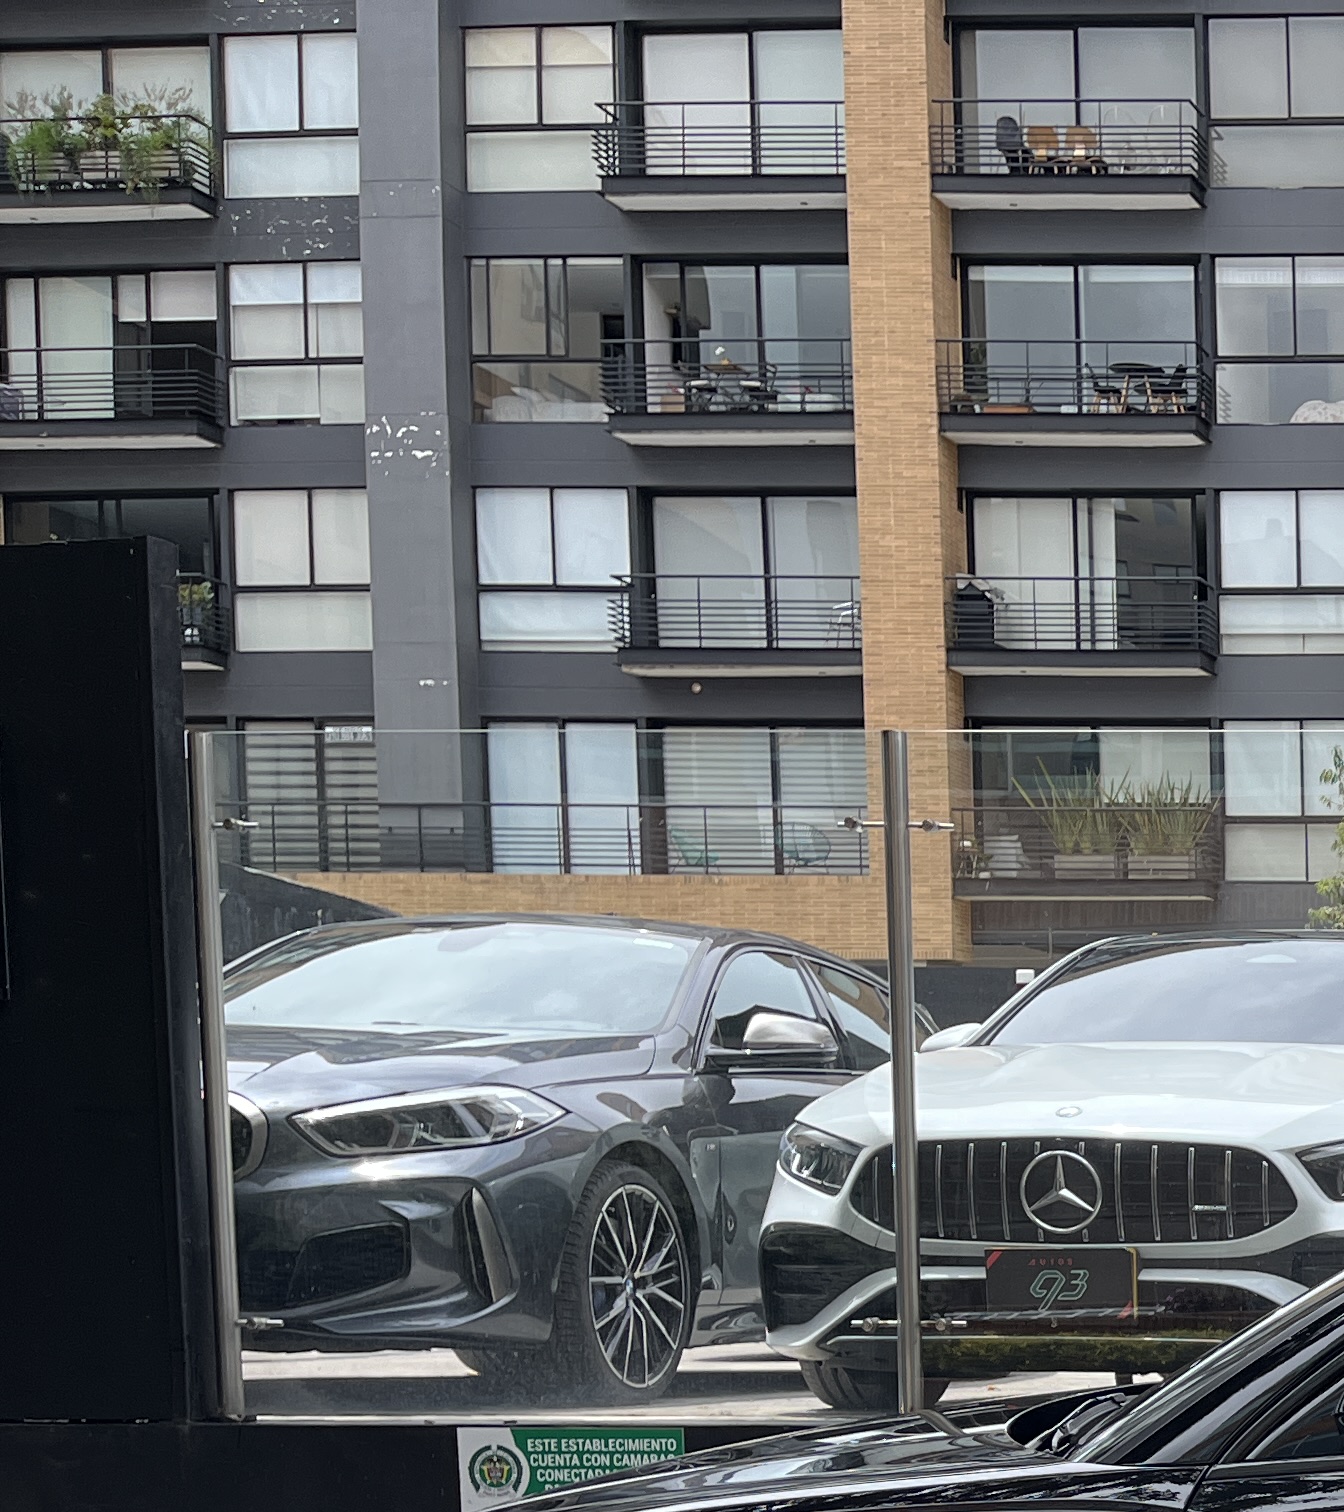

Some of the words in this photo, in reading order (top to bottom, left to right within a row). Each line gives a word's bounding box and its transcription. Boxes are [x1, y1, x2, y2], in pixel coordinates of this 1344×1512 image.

[1030, 1269, 1090, 1313] 93
[526, 1438, 559, 1452] ESTE
[561, 1438, 677, 1452] ESTABLECIMIENTO
[530, 1453, 580, 1467] CUENTA
[582, 1453, 611, 1467] CON
